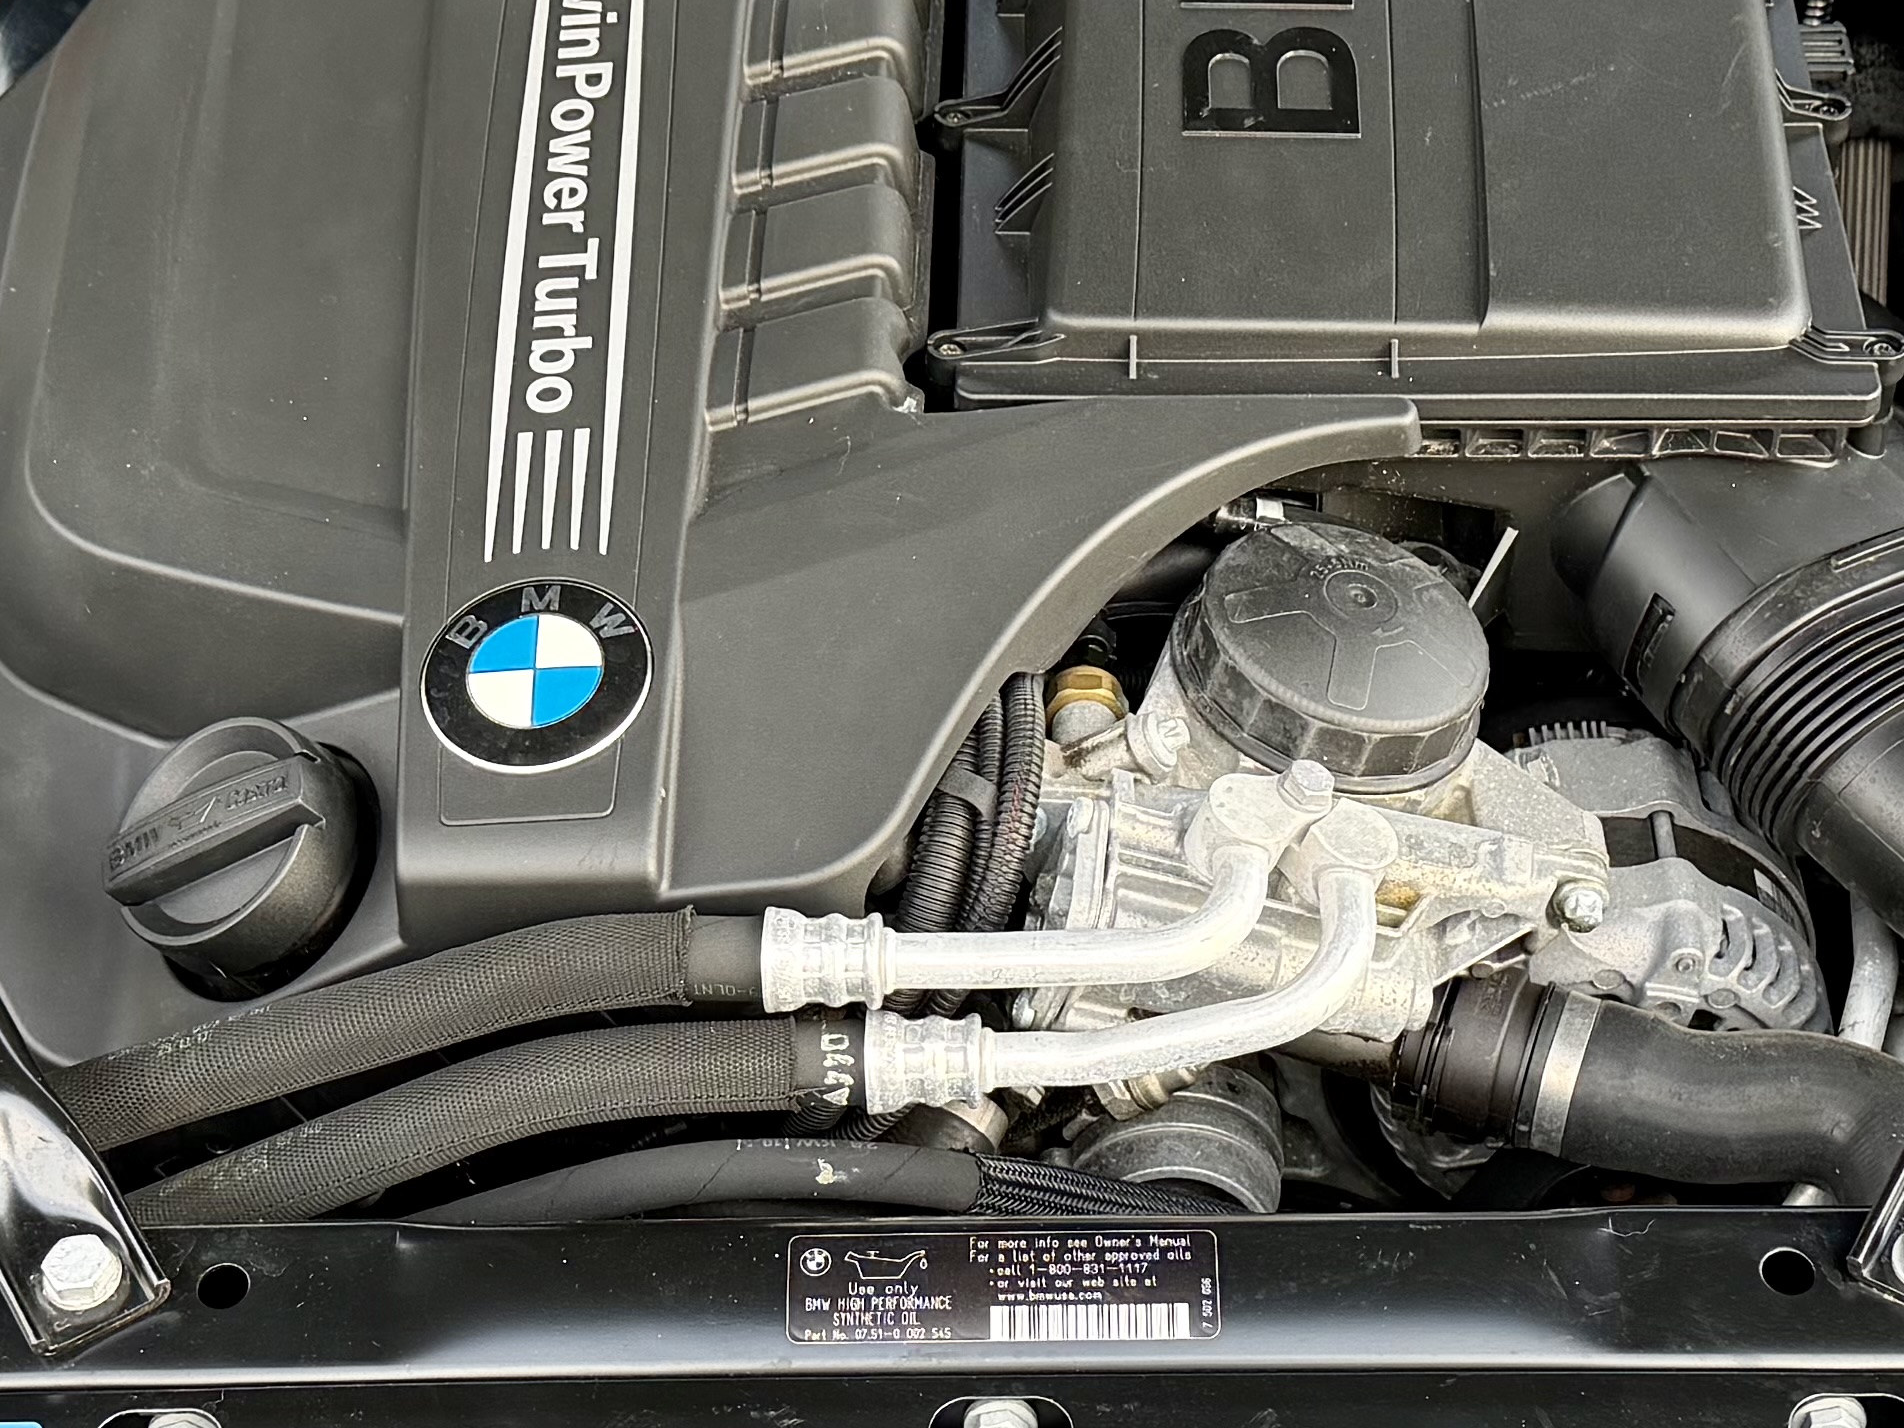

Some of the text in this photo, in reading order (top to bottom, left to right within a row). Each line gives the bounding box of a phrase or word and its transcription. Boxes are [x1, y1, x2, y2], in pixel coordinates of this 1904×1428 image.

[523, 239, 601, 413] Turbo
[446, 584, 636, 650] BMW
[969, 1237, 989, 1250] For
[998, 1240, 1026, 1248] more
[1035, 1238, 1059, 1248] info
[969, 1251, 989, 1262] For
[1013, 1251, 1035, 1261] list
[1064, 1250, 1096, 1261] other
[1105, 1250, 1159, 1262] approved
[849, 1281, 919, 1298] Use only
[805, 1296, 952, 1311] BMW HIGH PERFORMANCE
[833, 1312, 920, 1326] SYNTHETIC OIL
[805, 1329, 827, 1340] Part
